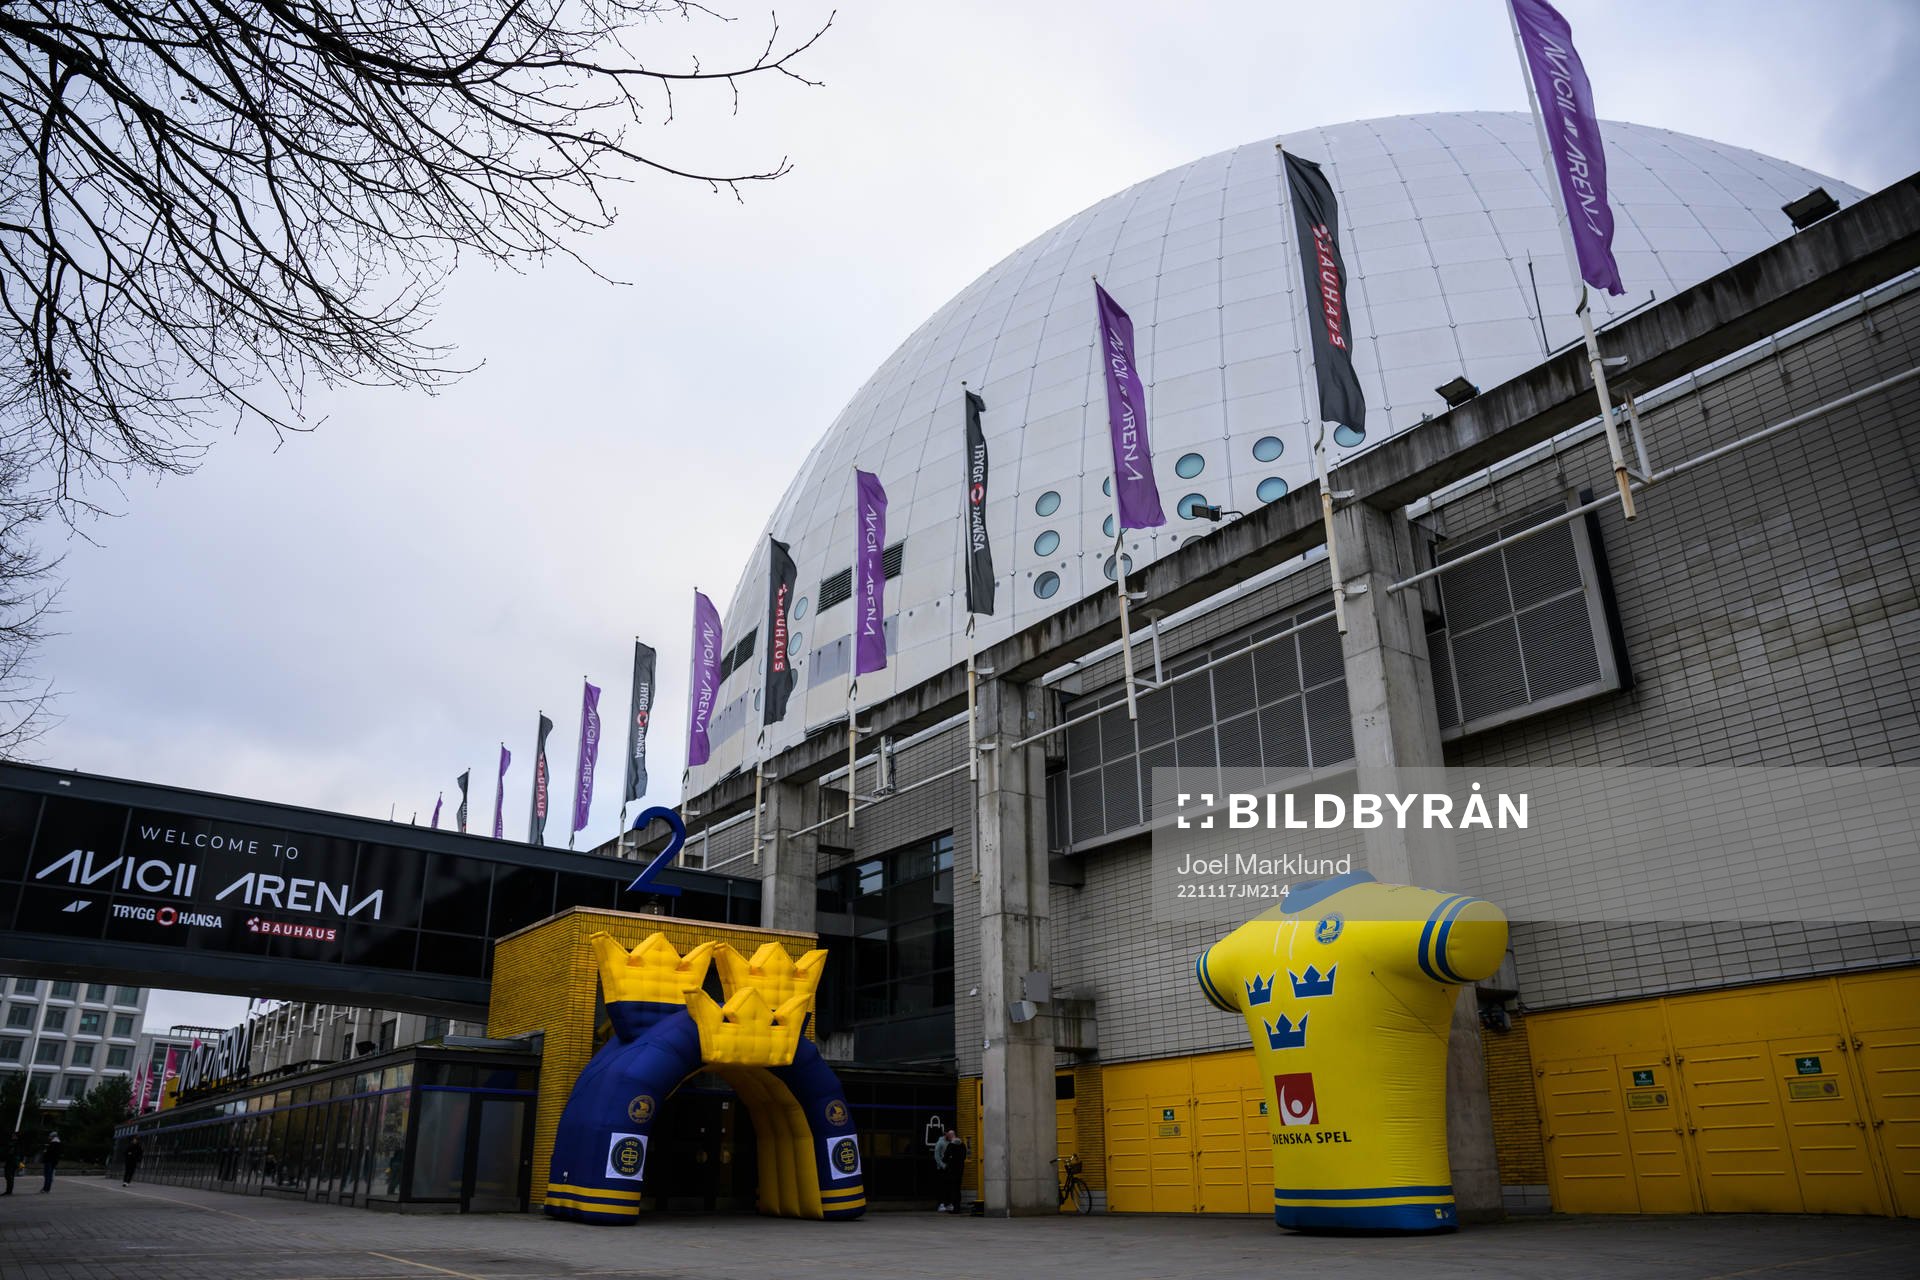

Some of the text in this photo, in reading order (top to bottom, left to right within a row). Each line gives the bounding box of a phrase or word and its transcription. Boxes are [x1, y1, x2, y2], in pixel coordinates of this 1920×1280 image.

[1539, 32, 1603, 237] AVICII ARENA
[1121, 401, 1144, 481] ARENA
[865, 503, 878, 553] AVICII
[695, 621, 715, 733] AVICII ARENA
[140, 824, 299, 860] WELCOME TO
[626, 806, 687, 896] 2
[35, 849, 383, 920] AVICII ARENA
[112, 904, 222, 929] TRYGG HANSA
[262, 922, 336, 940] BAUHAUS
[1272, 1131, 1352, 1145] SVENSKA SPEL
